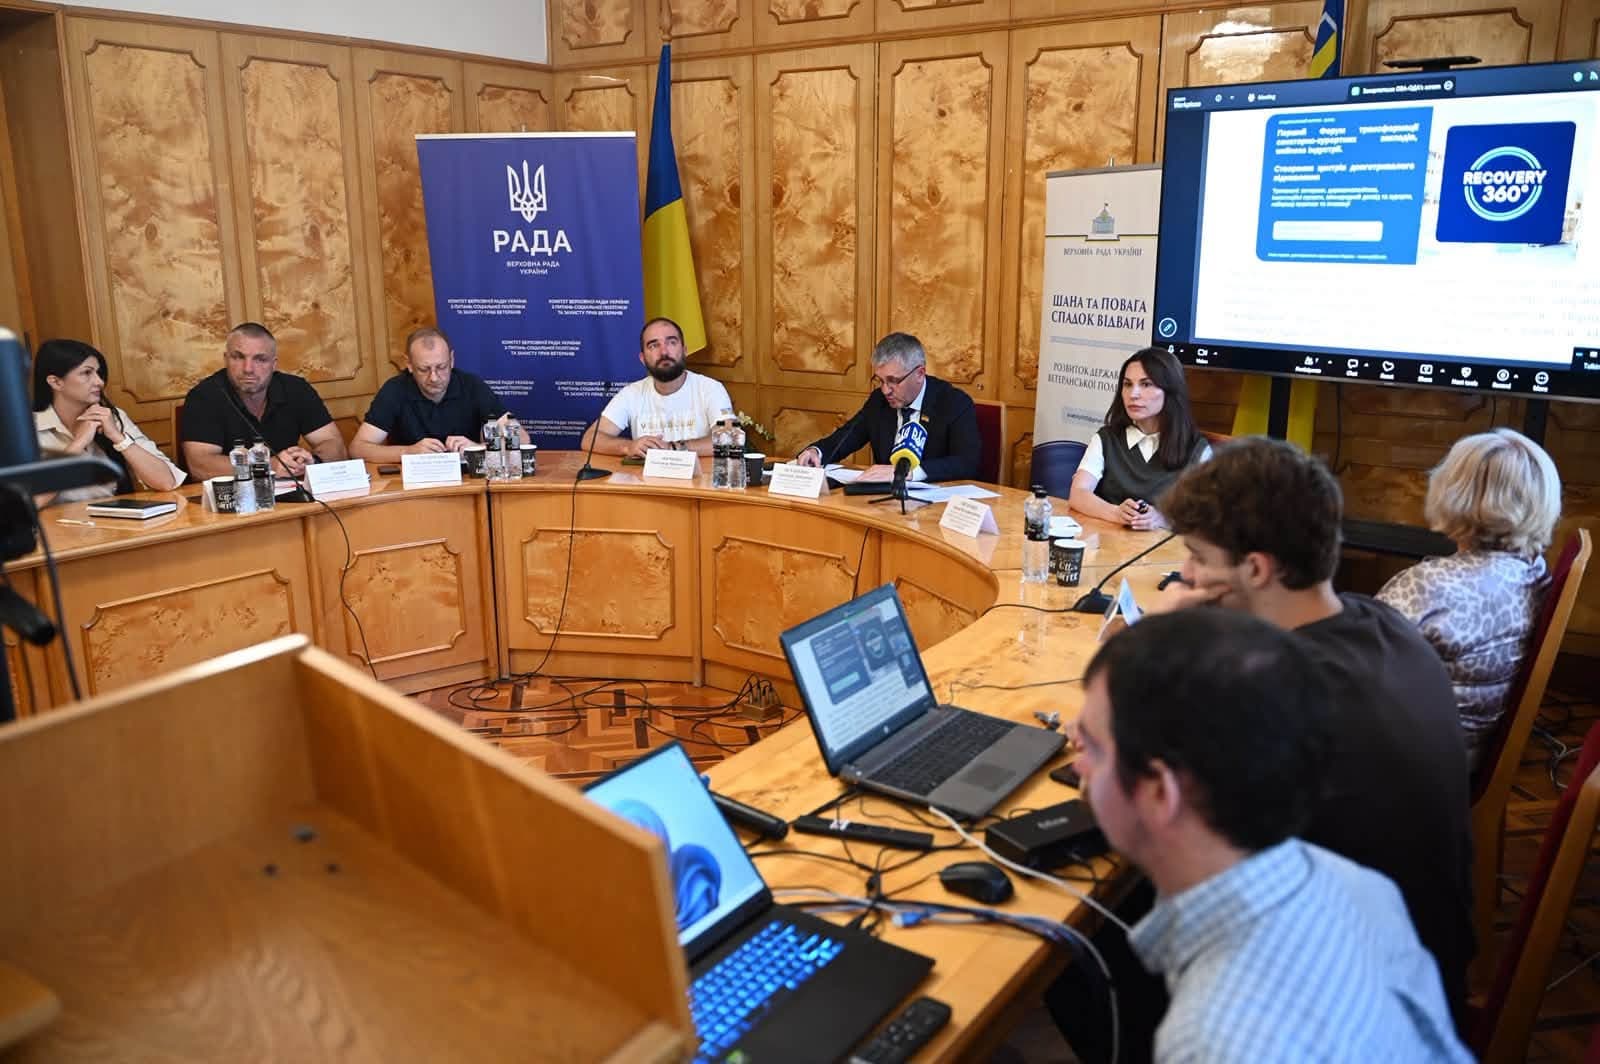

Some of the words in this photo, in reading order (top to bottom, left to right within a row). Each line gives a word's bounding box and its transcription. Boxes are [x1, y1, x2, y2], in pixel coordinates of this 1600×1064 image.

[1319, 127, 1346, 136] Форум
[1463, 170, 1547, 185] RECOVERY
[1482, 184, 1529, 203] 360°
[493, 230, 573, 257] РАДА
[1064, 248, 1093, 256] ВЕРХОВНА
[1096, 248, 1112, 256] РАДА
[1114, 246, 1142, 256] УКРАЇНИ
[520, 268, 549, 276] УКРАЇНИ
[1052, 294, 1084, 309] ШАНА
[1086, 298, 1098, 310] ТА
[1101, 298, 1147, 312] ПОВАГА
[1051, 310, 1095, 326] СПАДОК
[1097, 314, 1145, 330] ВІДВАГИ
[1054, 362, 1089, 376] РОЗВИТОК
[1090, 368, 1119, 380] ДЕРЖАВ
[1048, 374, 1096, 390] ВЕТЕРАНСЬКОЇ
[1532, 384, 1548, 393] More
